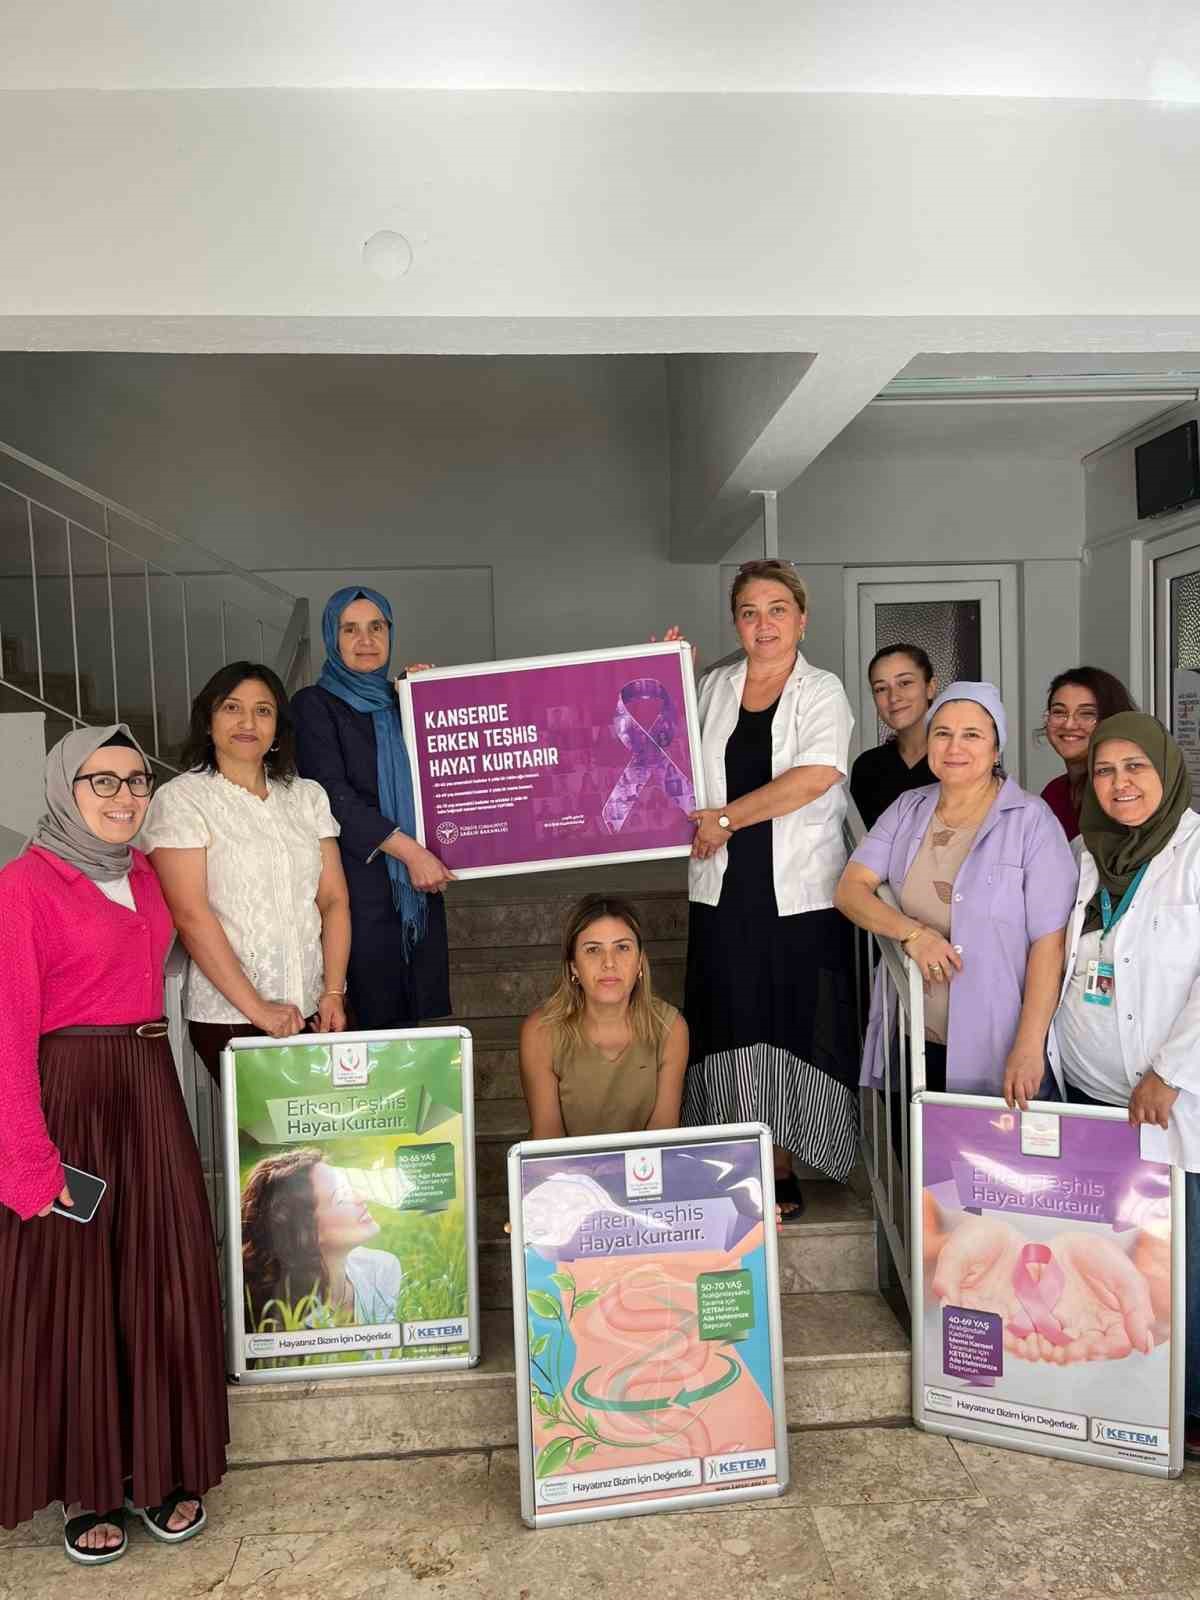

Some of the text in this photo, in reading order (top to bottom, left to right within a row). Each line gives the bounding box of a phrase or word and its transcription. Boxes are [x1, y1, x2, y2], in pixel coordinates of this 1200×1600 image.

[424, 703, 510, 729] KANSERDE
[427, 730, 480, 753] ERKEN
[429, 747, 559, 777] HAYAT KURTARIR
[287, 1095, 407, 1117] Erken Teşhis
[287, 1115, 408, 1136] Hayat Kurtarır.
[972, 1185, 1025, 1207] Hayat
[579, 1203, 705, 1232] Erken Teşhis
[579, 1228, 705, 1253] Hayat Kurtarır.
[417, 1325, 463, 1336] KETEM
[279, 1339, 316, 1350] Hayatınız
[317, 1336, 339, 1345] Bizim
[956, 1399, 995, 1414] Hayatınız
[996, 1407, 1020, 1420] Bizim
[1036, 1414, 1080, 1431] Değerlidir.
[1106, 1427, 1159, 1444] KETEM
[720, 1458, 766, 1472] KETEM
[572, 1480, 612, 1493] Hayatınız
[613, 1476, 637, 1487] Bizim
[637, 1472, 652, 1485] İçin
[653, 1469, 695, 1481] Değerlidir.
